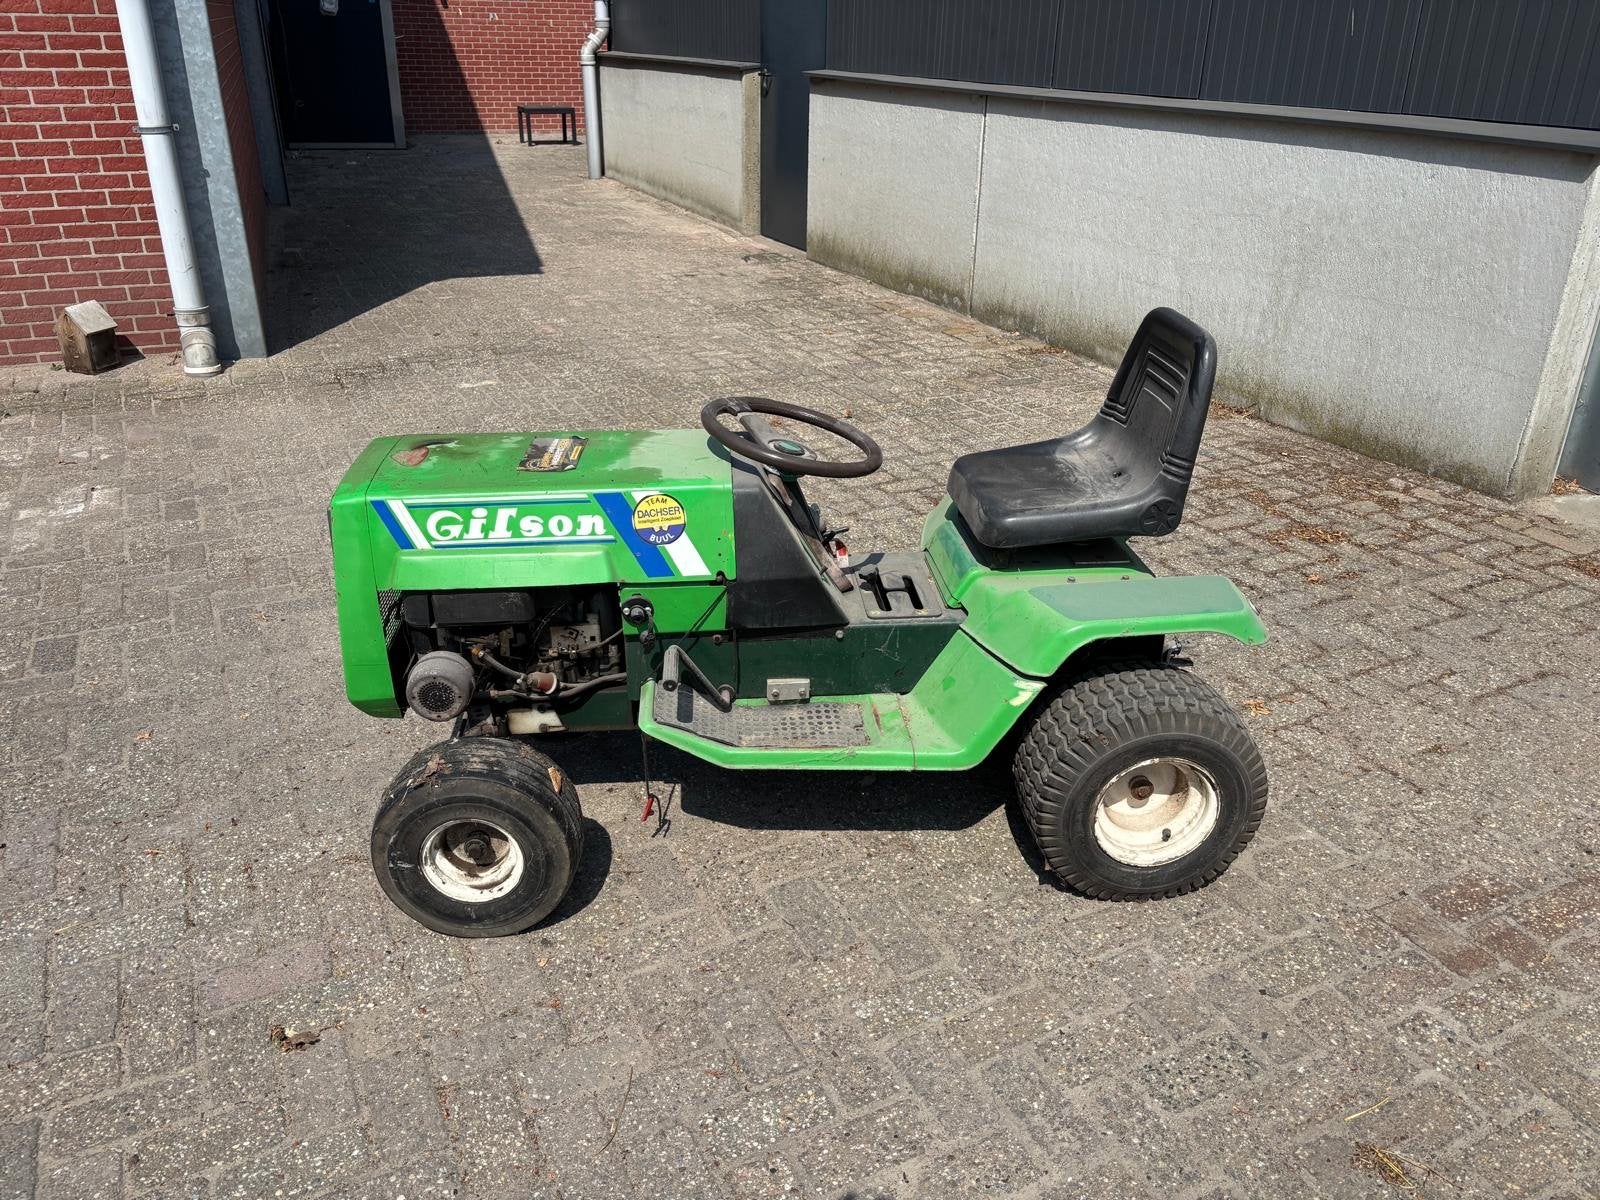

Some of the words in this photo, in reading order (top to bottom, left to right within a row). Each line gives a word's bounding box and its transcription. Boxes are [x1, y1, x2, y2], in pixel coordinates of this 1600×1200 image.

[646, 497, 667, 506] TEAM
[637, 506, 681, 518] DACHSER
[427, 507, 607, 541] Gilson
[649, 533, 675, 543] BUUL
